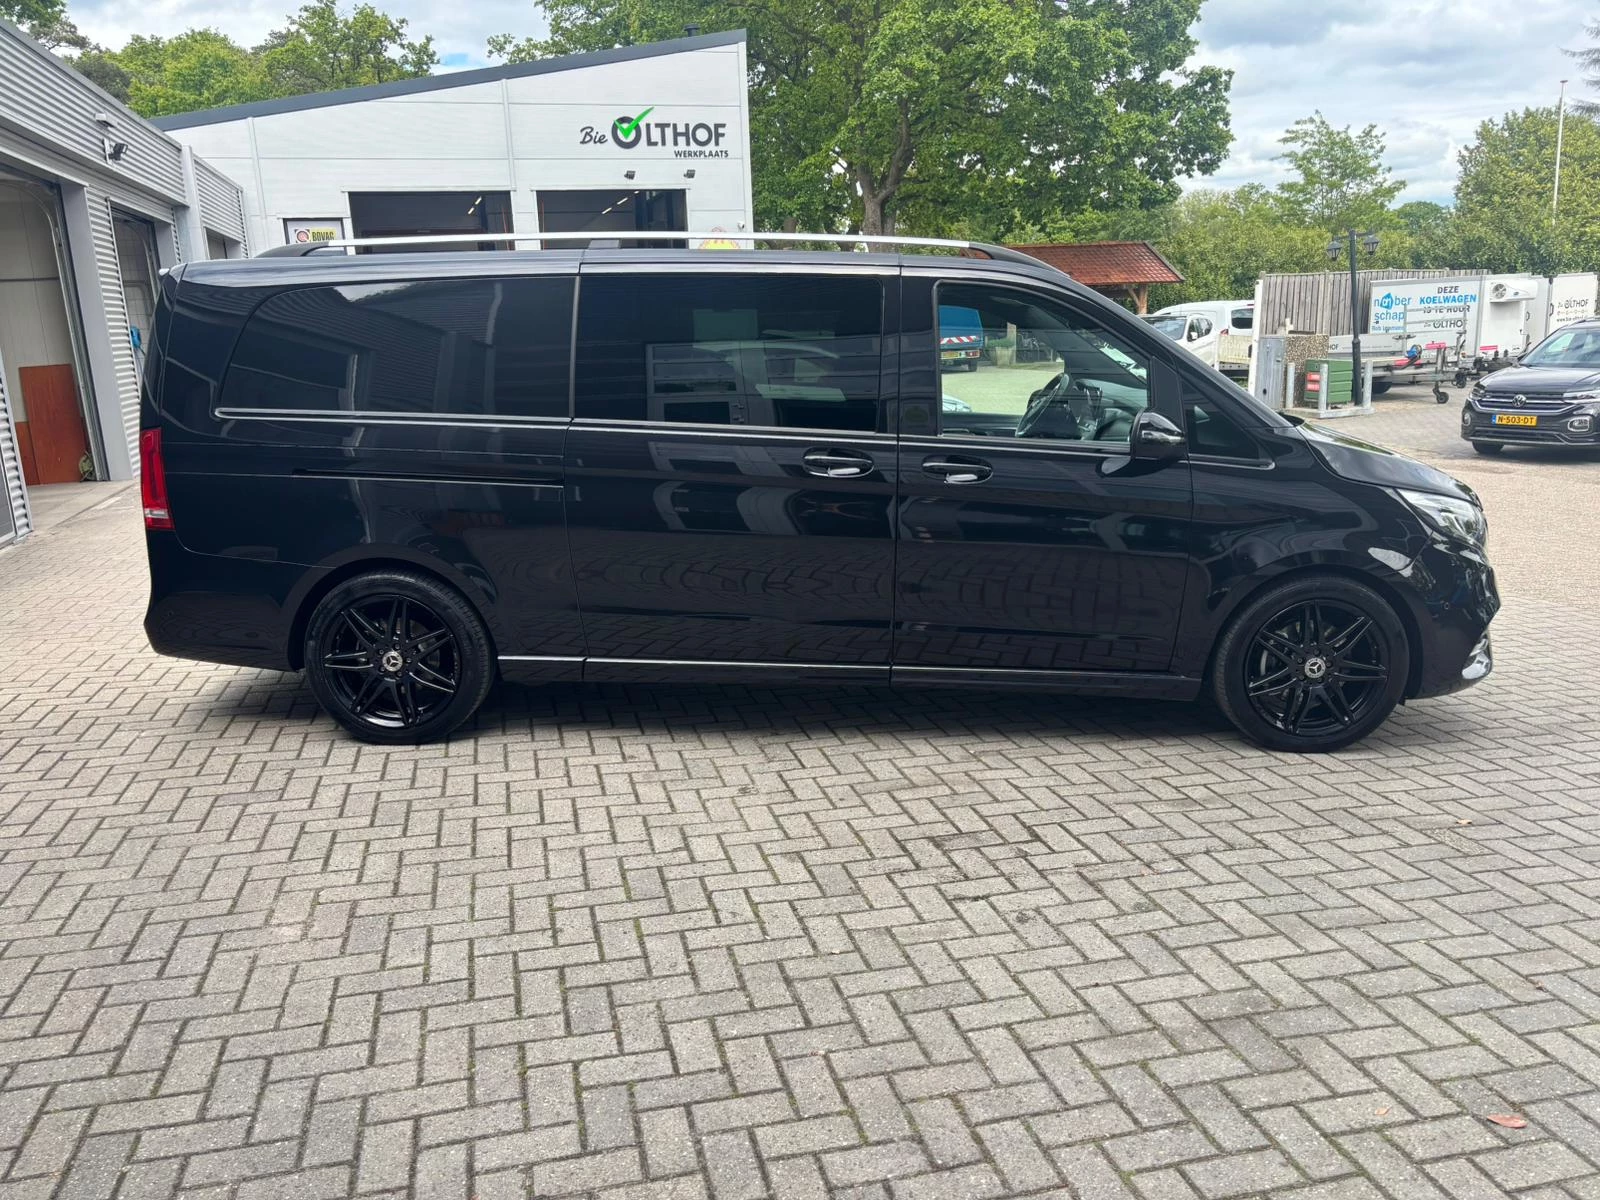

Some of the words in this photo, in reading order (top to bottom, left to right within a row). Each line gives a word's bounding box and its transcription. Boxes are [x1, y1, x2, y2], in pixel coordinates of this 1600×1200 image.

[579, 126, 608, 145] Bie
[611, 115, 727, 149] OLTHOF
[673, 150, 729, 158] WERKPLAATS
[1437, 285, 1460, 294] DEZE
[1419, 294, 1477, 305] KOELWAGEN
[1564, 298, 1589, 309] OLTHOF
[1434, 305, 1443, 313] TE
[1374, 310, 1405, 323] schap
[1497, 415, 1534, 425] N-503-DT
